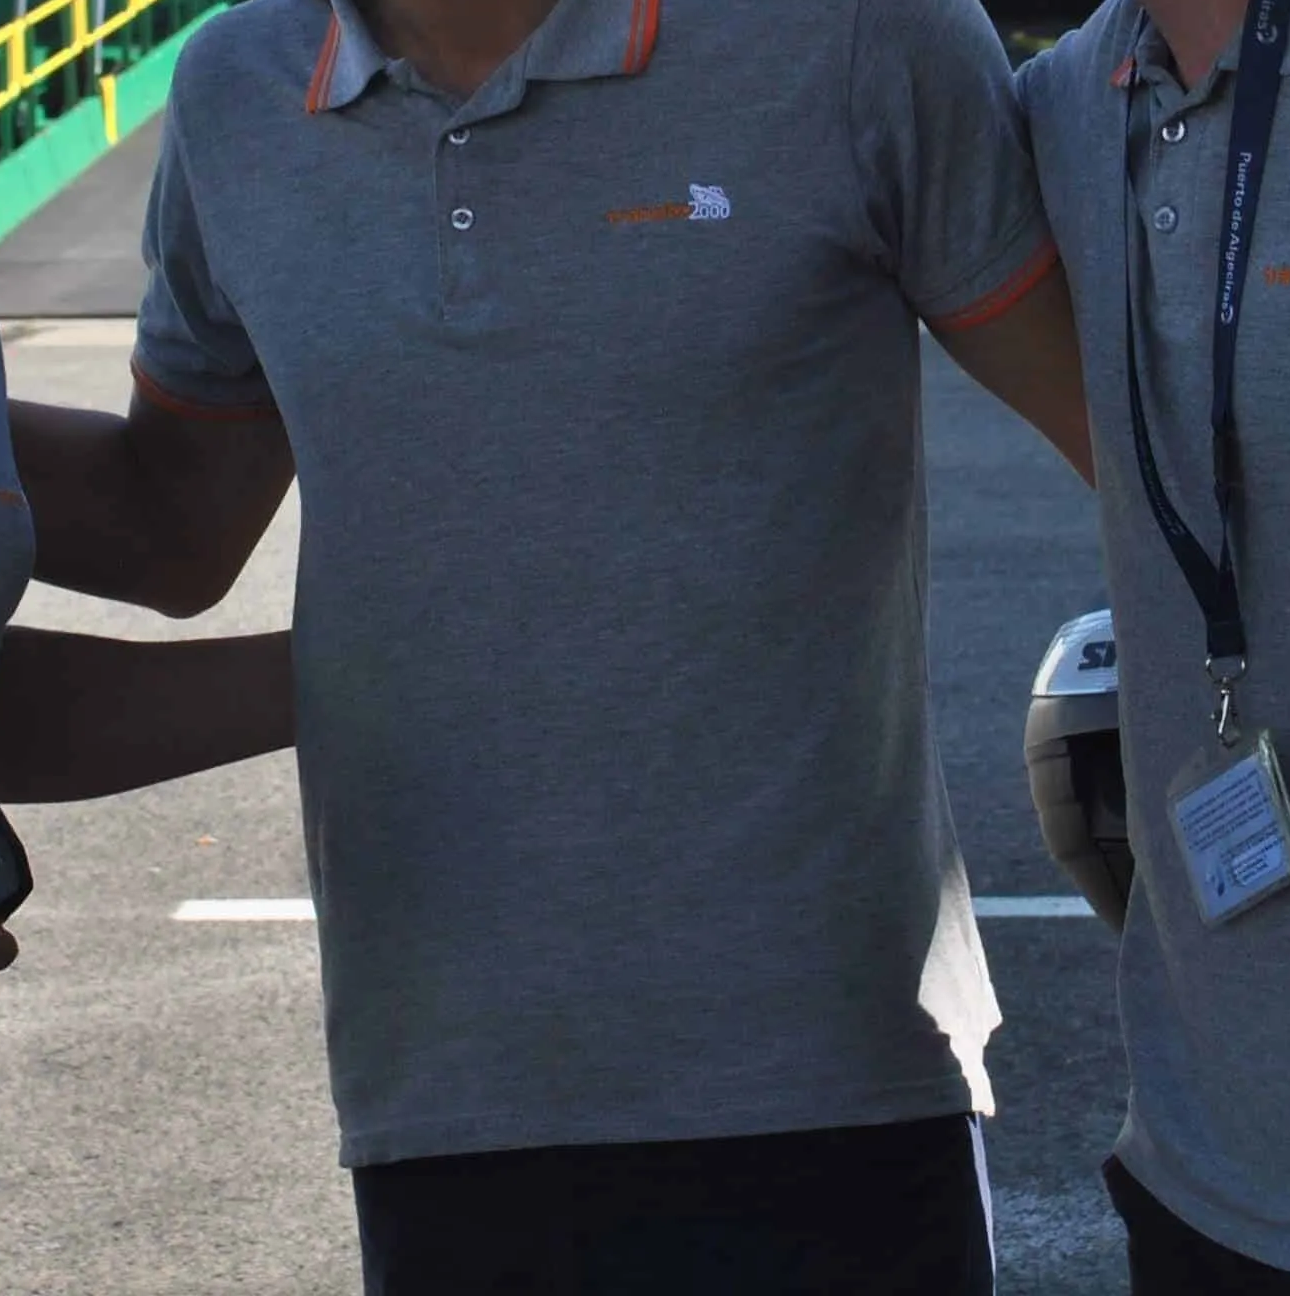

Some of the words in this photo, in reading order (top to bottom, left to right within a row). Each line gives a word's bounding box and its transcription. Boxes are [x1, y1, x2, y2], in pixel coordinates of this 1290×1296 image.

[1233, 151, 1253, 207] Puerto
[1230, 210, 1243, 230] de
[1221, 232, 1240, 310] Algeciras
